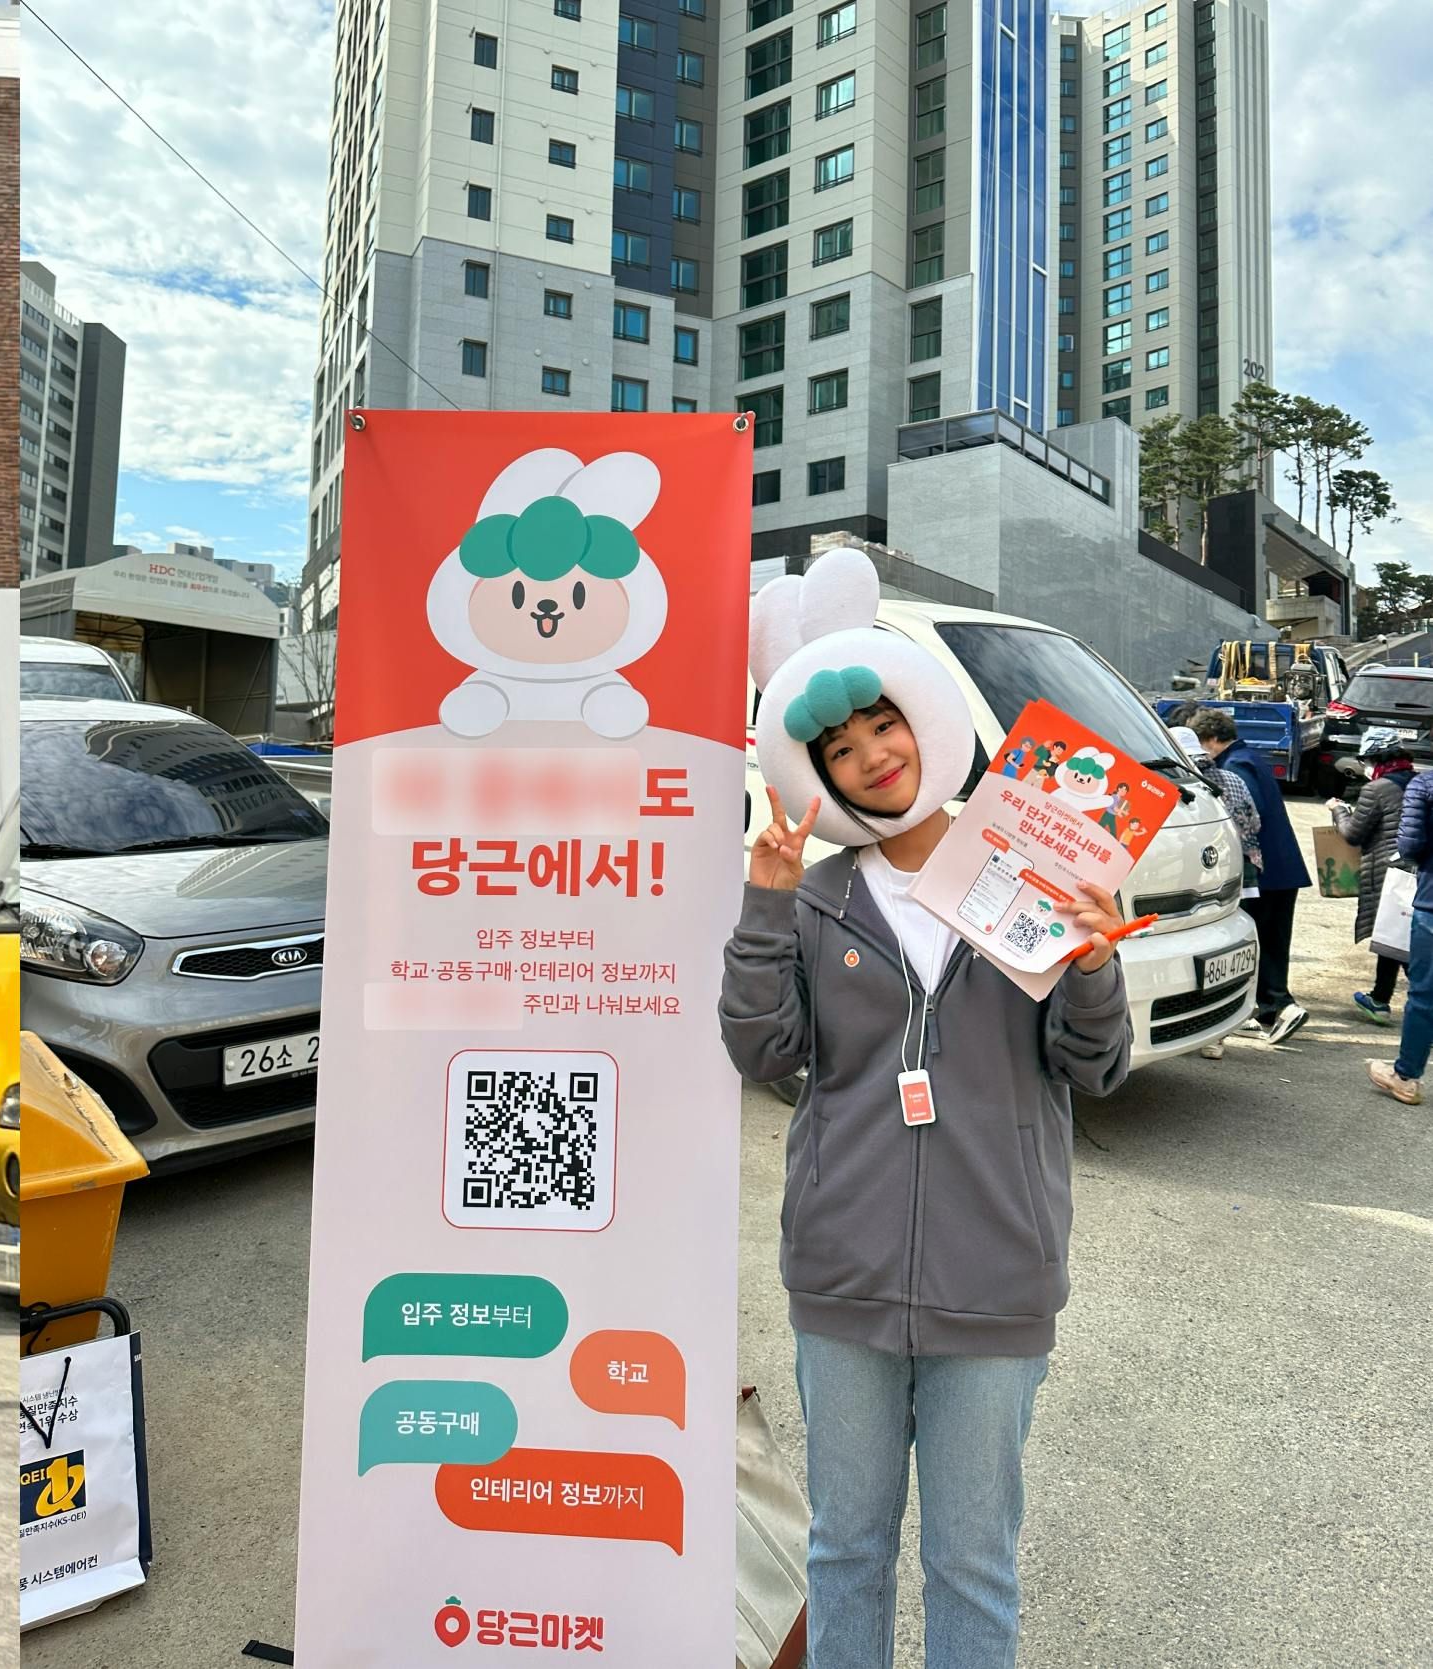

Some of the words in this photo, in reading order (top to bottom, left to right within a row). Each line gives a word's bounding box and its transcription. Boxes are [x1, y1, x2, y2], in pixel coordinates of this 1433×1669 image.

[1243, 358, 1265, 383] 202
[149, 563, 176, 577] HDC
[1000, 790, 1026, 812] 우리
[1026, 805, 1052, 827] 단지
[1051, 821, 1112, 865] 커뮤니티를
[1018, 819, 1078, 863] 만나보세요
[411, 837, 665, 898] 당근에서!
[476, 929, 514, 950] 입주
[519, 929, 595, 951] 정보부터
[278, 950, 303, 963] KIA
[1230, 948, 1252, 976] 4729
[601, 962, 677, 984] 정보까지
[523, 994, 581, 1015] 주민과
[585, 994, 682, 1017] 나눠보세요
[240, 1044, 293, 1078] 26소
[401, 1302, 443, 1327] 입주
[449, 1303, 532, 1329] 정보부터
[607, 1360, 650, 1385] 학교
[57, 1408, 79, 1424] 수상
[395, 1410, 480, 1436] 공동구매
[470, 1477, 553, 1505] 인테리어
[560, 1481, 645, 1511] 정보까지
[31, 1554, 98, 1585] 시스템에어컨
[476, 1609, 604, 1652] 당근마켓
